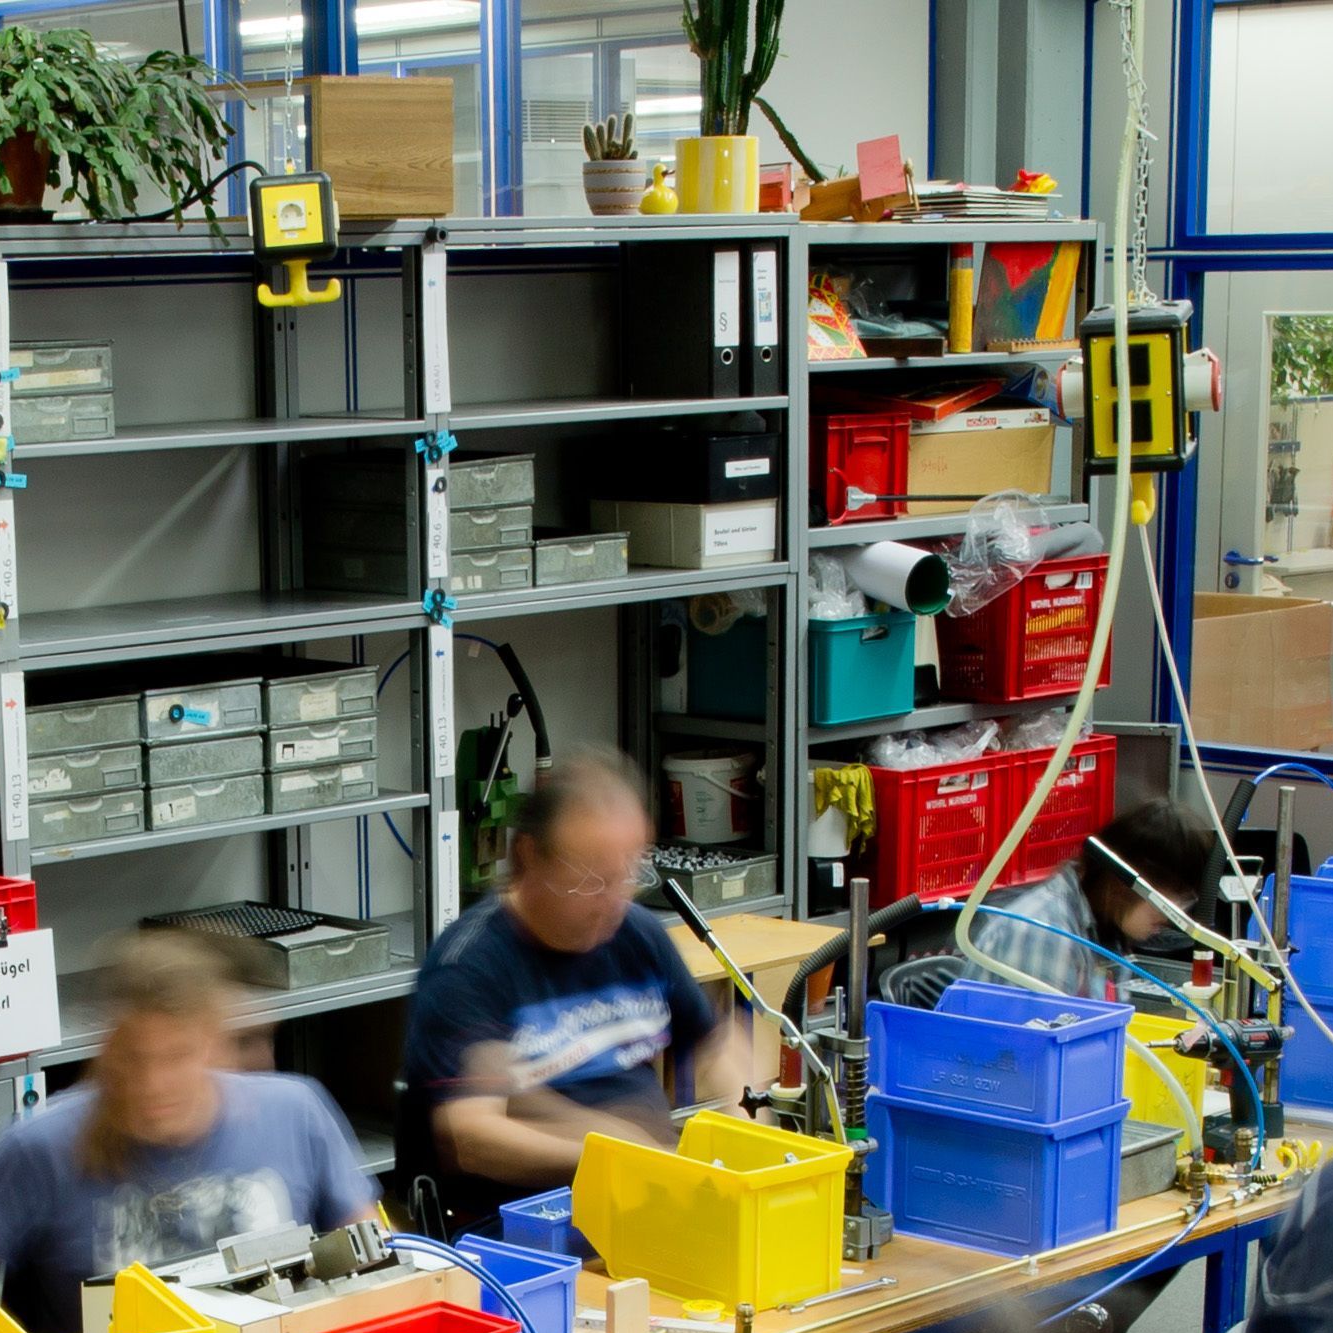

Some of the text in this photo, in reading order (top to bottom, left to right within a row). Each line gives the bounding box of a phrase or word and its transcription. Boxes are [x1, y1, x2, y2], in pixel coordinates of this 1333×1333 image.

[437, 715, 449, 768] LT 40.13
[11, 773, 22, 809] 40.13
[12, 810, 23, 829] LT
